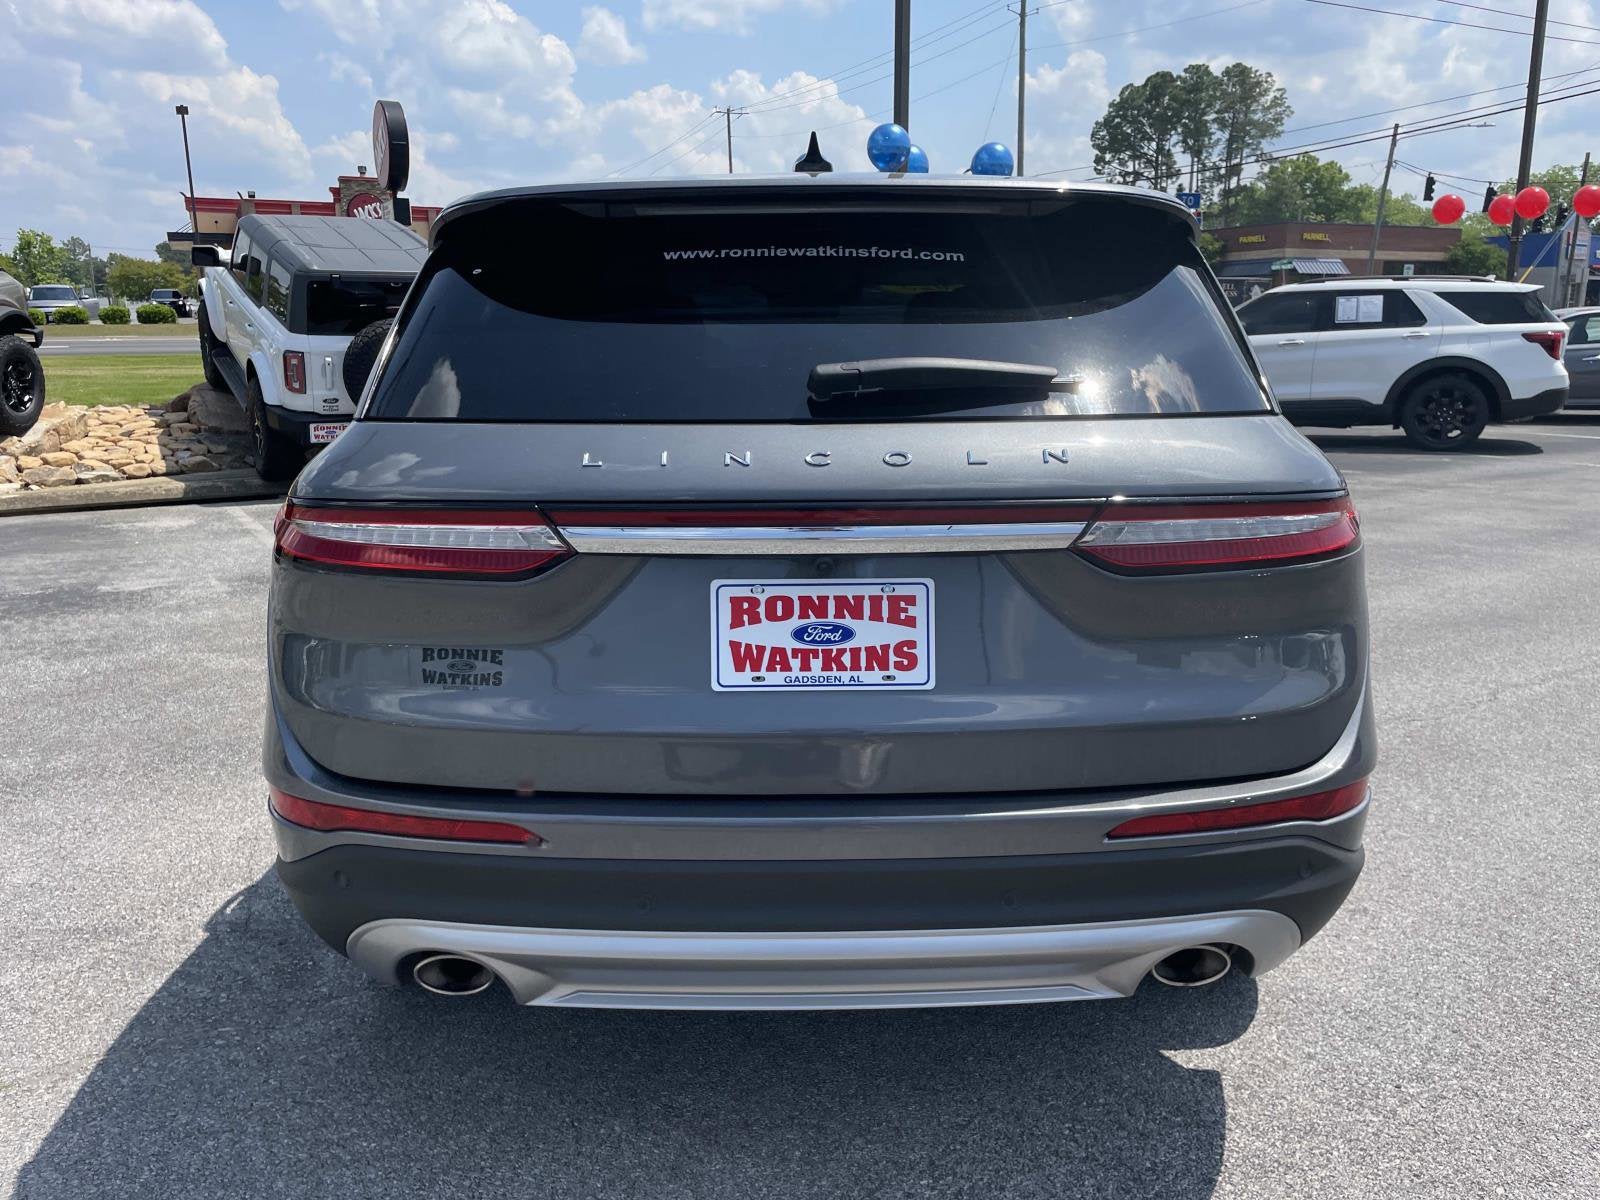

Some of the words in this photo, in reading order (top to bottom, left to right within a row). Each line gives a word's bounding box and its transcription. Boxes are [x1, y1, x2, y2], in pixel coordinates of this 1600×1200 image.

[1303, 232, 1329, 241] PARNELL
[663, 245, 966, 262] www.ronniewatkinsford.com
[582, 448, 1070, 467] LINCOLN
[729, 594, 917, 630] RONNIE
[803, 625, 844, 642] Ford
[422, 647, 504, 666] RONNIE
[728, 639, 919, 673] WATKINS
[422, 668, 503, 687] WATKINS
[784, 675, 846, 685] GADSDEN,
[848, 674, 864, 684] AL
